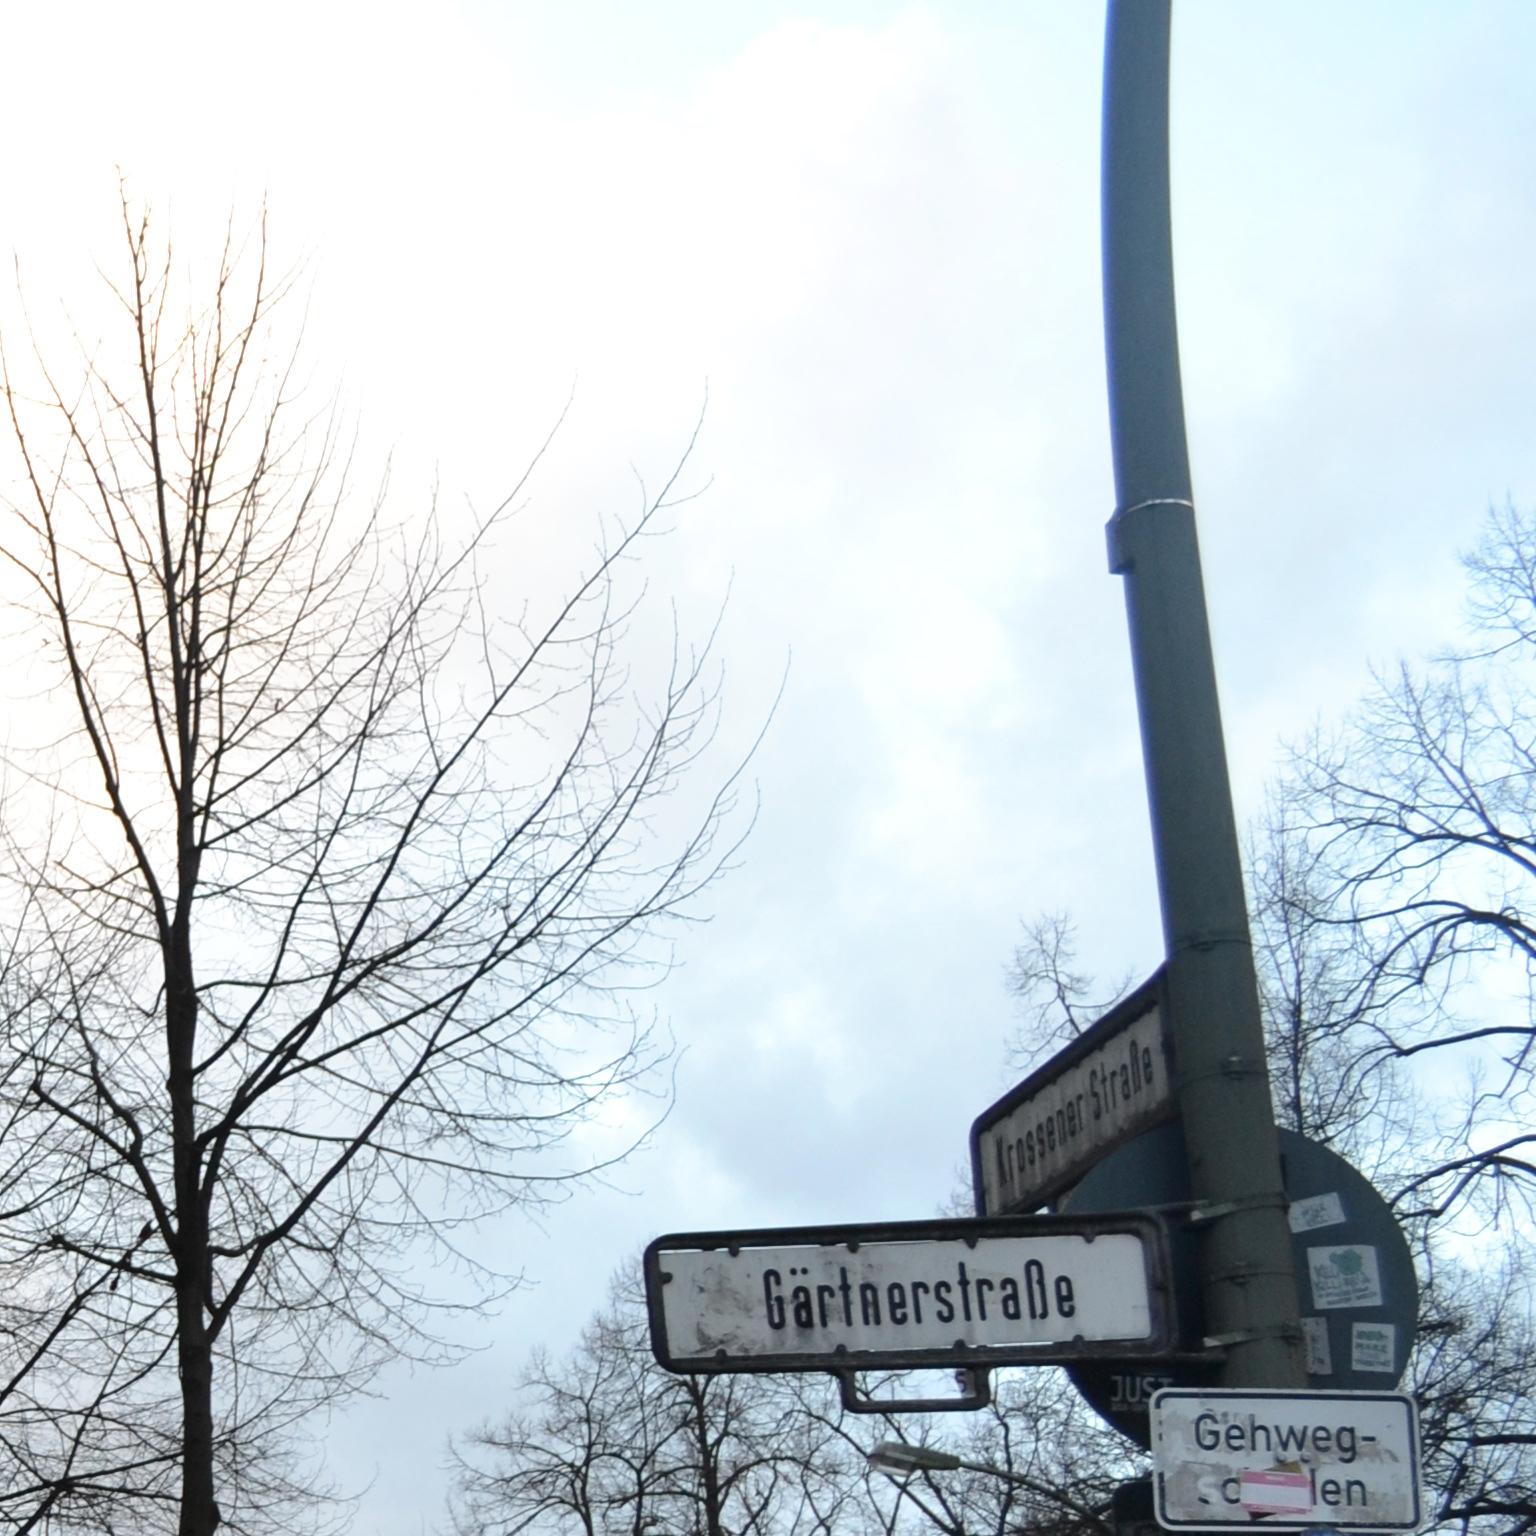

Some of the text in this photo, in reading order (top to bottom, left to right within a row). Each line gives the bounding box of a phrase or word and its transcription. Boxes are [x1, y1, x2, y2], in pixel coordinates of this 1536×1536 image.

[995, 1040, 1153, 1188] Krossener Straße
[763, 1257, 1076, 1331] Gärtnerstraße
[1194, 1413, 1376, 1463] Gehweg-
